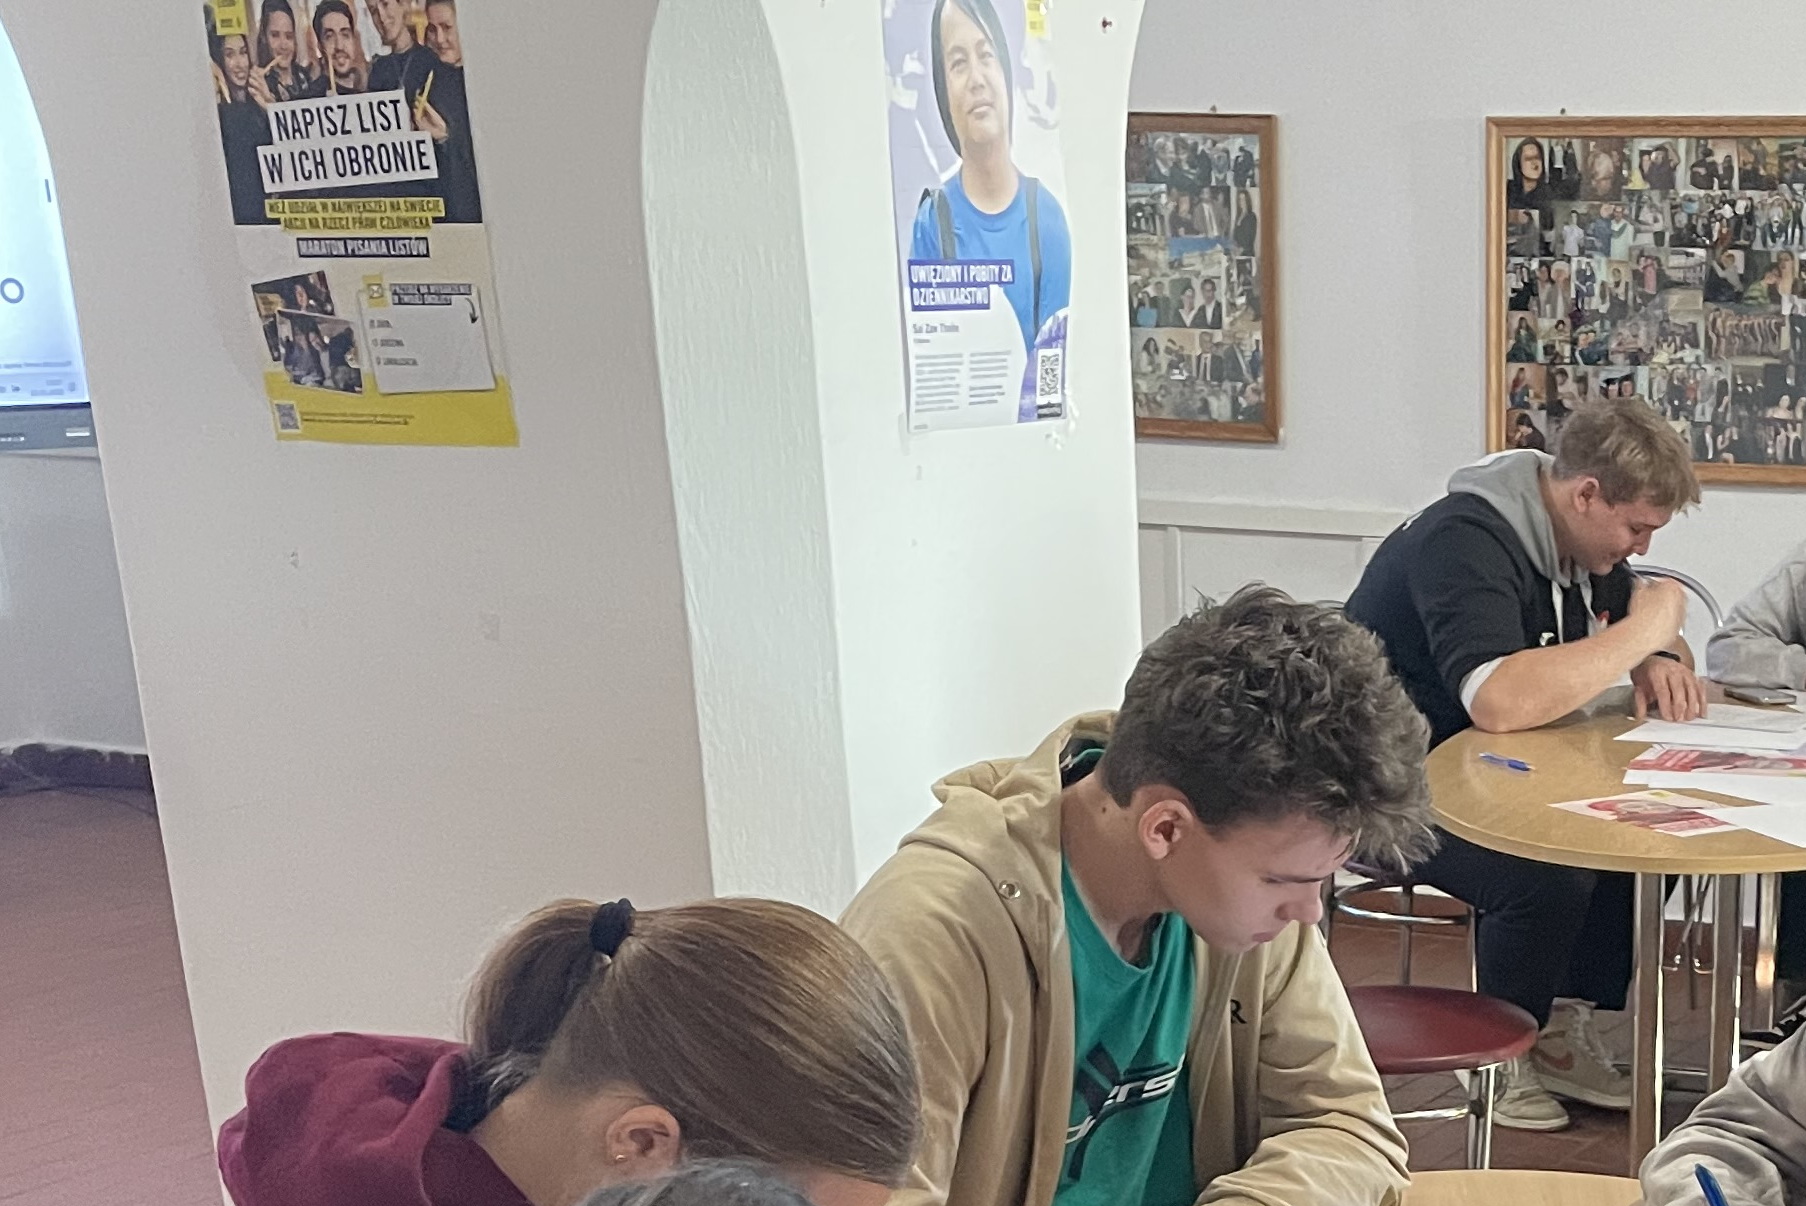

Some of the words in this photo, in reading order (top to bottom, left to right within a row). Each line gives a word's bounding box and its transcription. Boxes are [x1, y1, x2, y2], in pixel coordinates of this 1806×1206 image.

[274, 104, 351, 141] NAPISZ
[356, 99, 402, 133] LIST
[263, 152, 283, 184] W
[290, 149, 328, 182] ICH
[333, 140, 431, 178] OBRONIE
[1001, 264, 1013, 282] ZA
